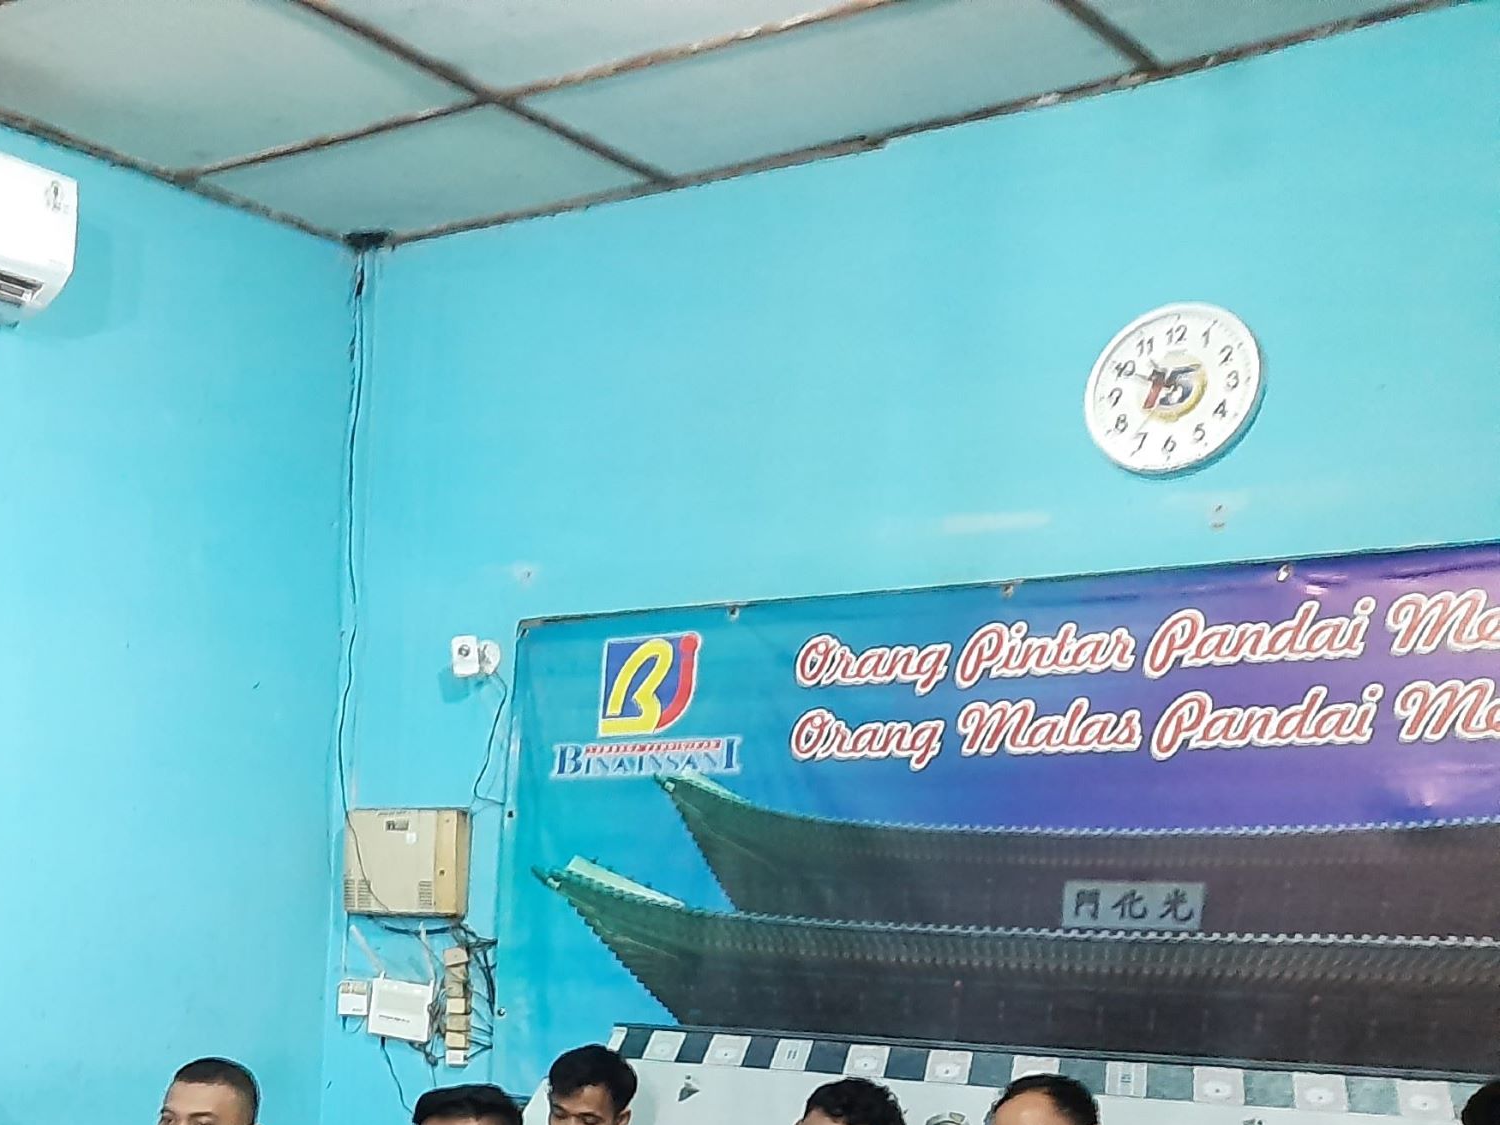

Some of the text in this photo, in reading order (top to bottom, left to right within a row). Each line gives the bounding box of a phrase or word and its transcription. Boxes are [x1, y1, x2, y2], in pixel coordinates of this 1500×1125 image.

[1166, 325, 1188, 344] 12
[1136, 337, 1155, 356] 11
[1219, 345, 1234, 365] 2
[1114, 360, 1136, 379] 10
[1226, 370, 1240, 390] 3
[1108, 387, 1123, 407] 9
[1213, 399, 1227, 418] 4
[1114, 414, 1128, 433] 8
[1193, 423, 1206, 443] 5
[1134, 432, 1148, 454] 7
[1162, 434, 1177, 453] 6
[796, 634, 950, 694] Orang
[956, 622, 1135, 688] Pintar
[1144, 597, 1376, 678] Pandai
[792, 709, 945, 770] Orang
[957, 698, 1141, 755] Malas
[1151, 683, 1383, 760] Pandai
